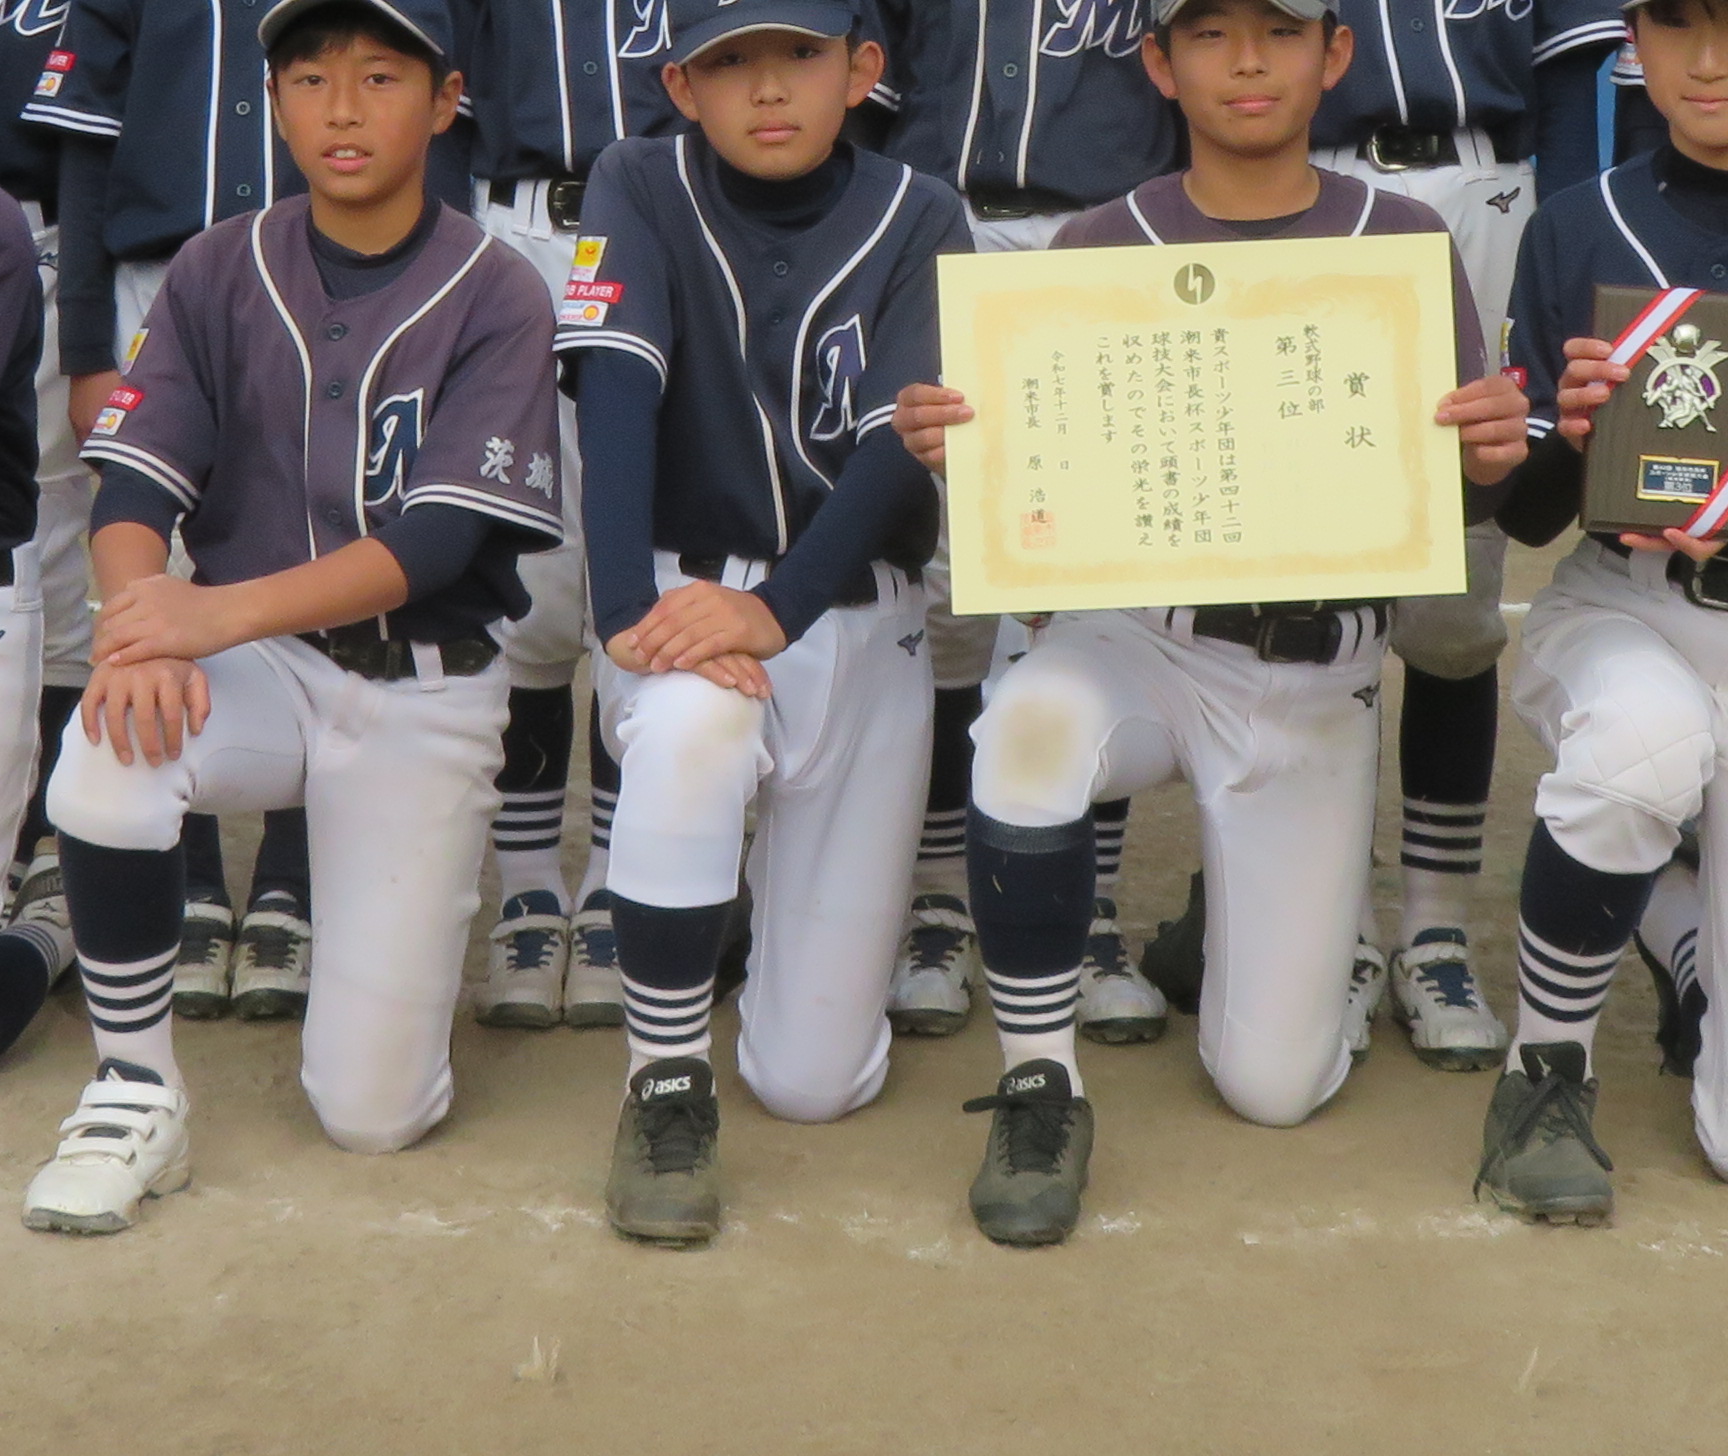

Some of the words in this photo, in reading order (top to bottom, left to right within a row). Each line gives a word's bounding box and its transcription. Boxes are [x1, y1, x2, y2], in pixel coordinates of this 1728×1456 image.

[576, 284, 614, 298] PLAYER
[1096, 336, 1118, 444] これを賞します
[1275, 336, 1303, 420] 第三位
[1303, 324, 1325, 414] 軟式野球の部
[1343, 372, 1376, 449] 賞状
